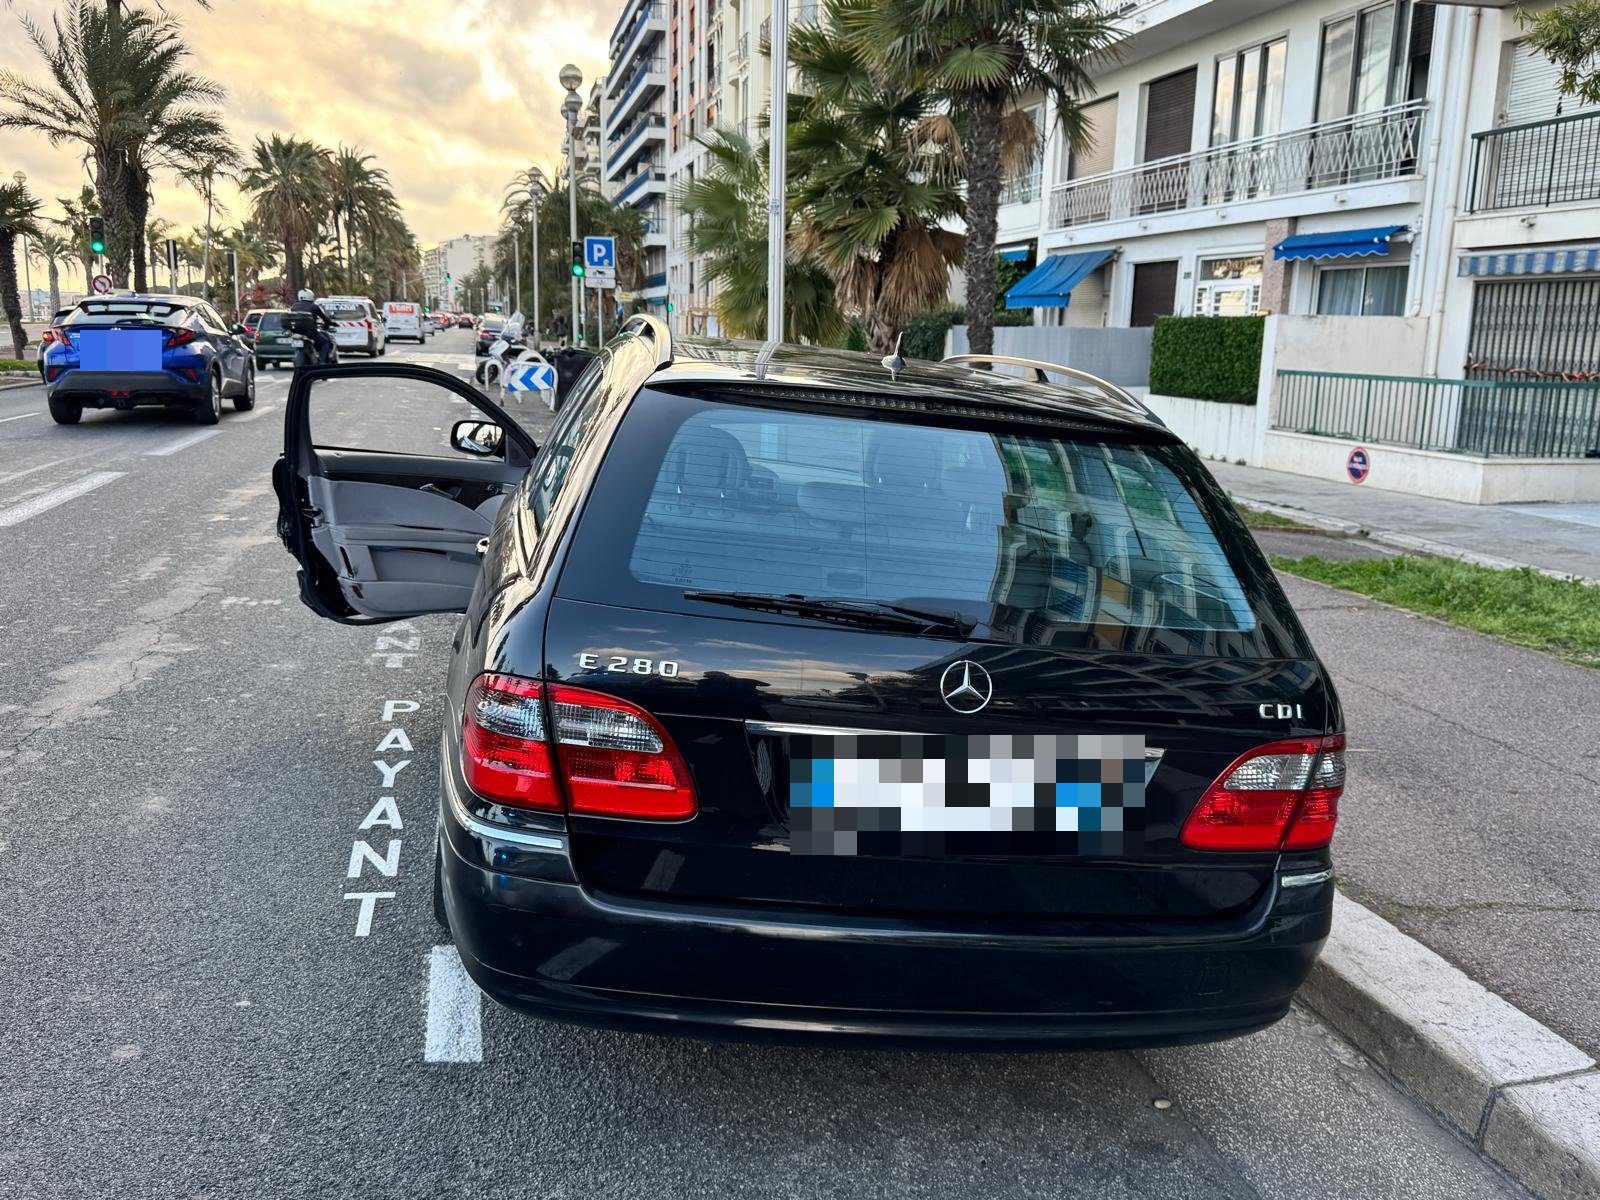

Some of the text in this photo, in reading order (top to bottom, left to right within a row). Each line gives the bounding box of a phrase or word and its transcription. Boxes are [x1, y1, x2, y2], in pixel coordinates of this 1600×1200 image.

[593, 244, 606, 262] P
[578, 653, 678, 677] E 280
[1259, 703, 1303, 720] CDI
[344, 700, 421, 937] PAYANT
